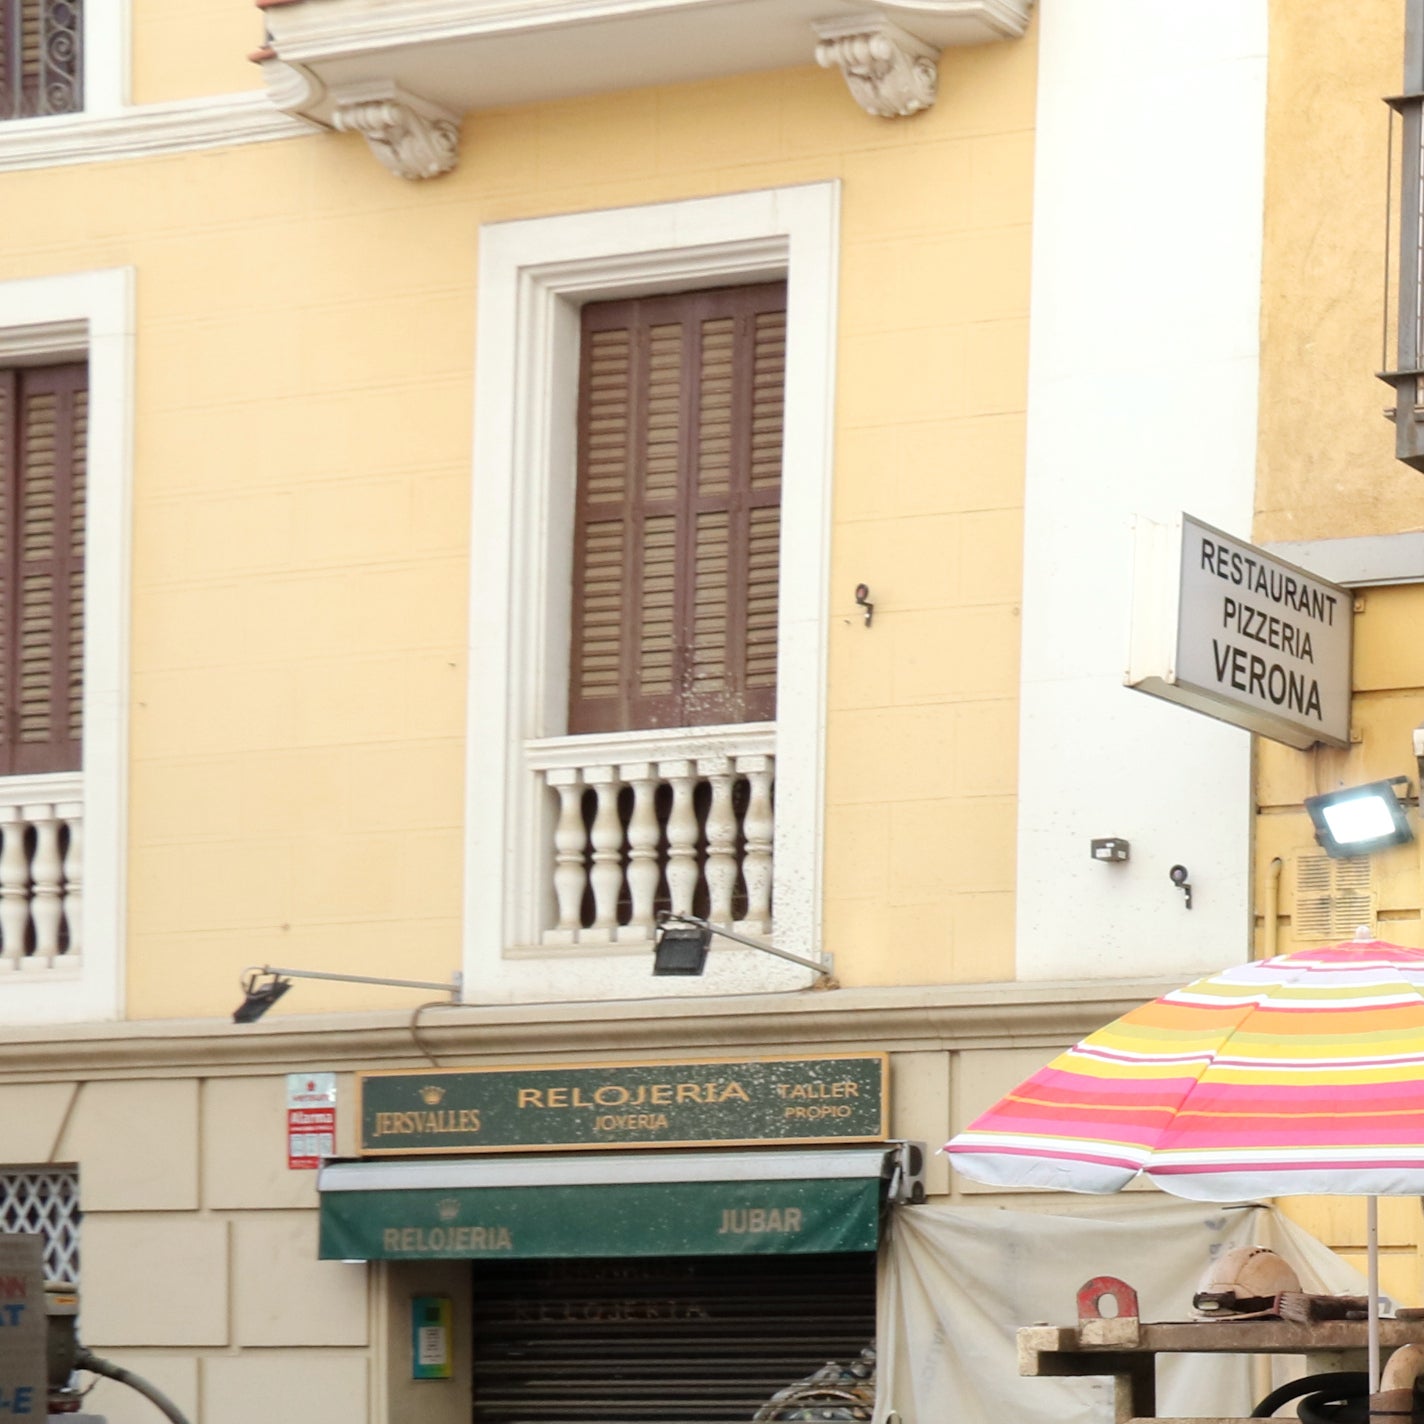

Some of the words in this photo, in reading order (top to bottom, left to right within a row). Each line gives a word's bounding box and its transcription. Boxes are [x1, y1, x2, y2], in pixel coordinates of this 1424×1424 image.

[1201, 537, 1336, 626] RESTAURANT
[1223, 597, 1313, 664] PIZZERIA
[1212, 639, 1322, 720] VERONA
[517, 1081, 750, 1109] RELOJERIA
[777, 1083, 860, 1099] TALLER
[372, 1109, 481, 1137] JERSVALLES
[593, 1114, 669, 1130] JOYERIA
[785, 1105, 851, 1119] PROPIO
[718, 1207, 802, 1234] JUBAR
[383, 1227, 513, 1251] RELOJERIA
